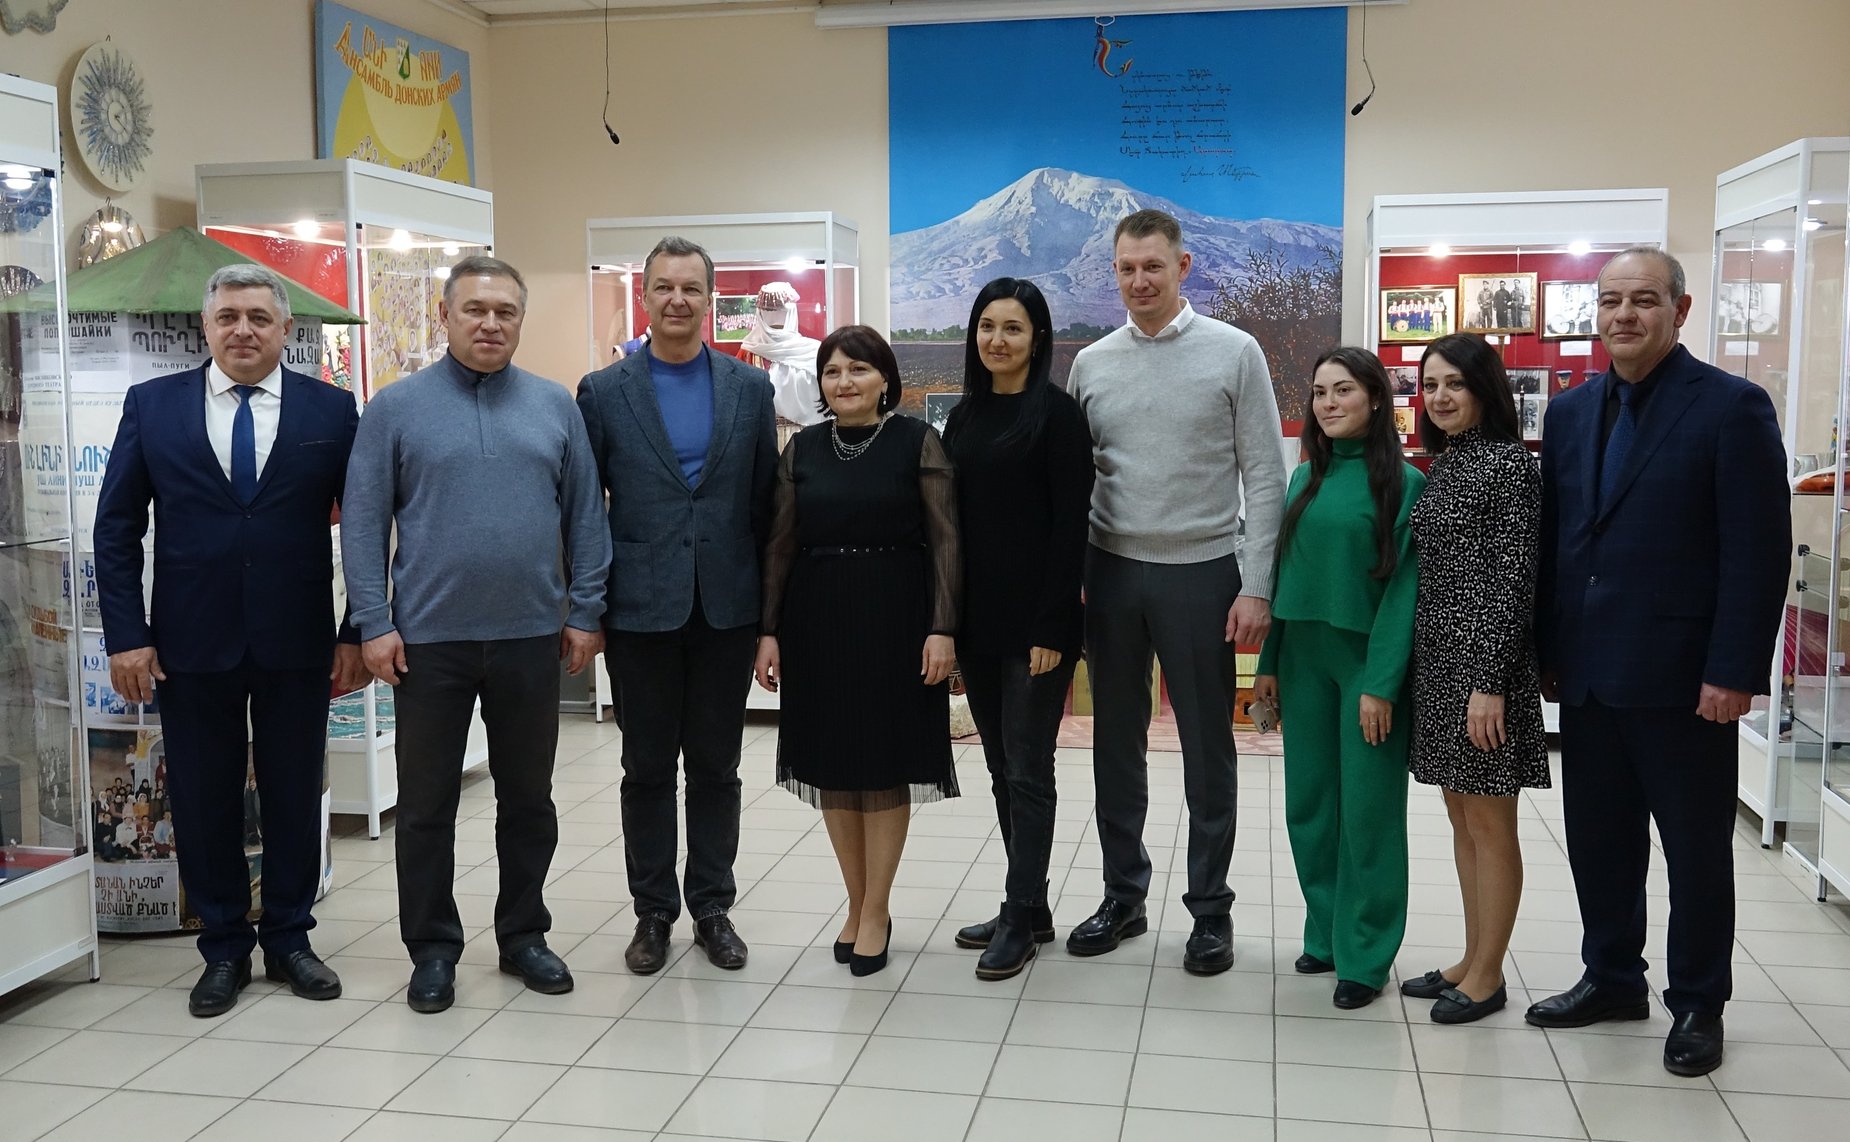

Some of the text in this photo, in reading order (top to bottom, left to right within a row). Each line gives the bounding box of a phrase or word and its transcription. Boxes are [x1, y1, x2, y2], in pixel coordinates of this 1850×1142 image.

[335, 22, 462, 107] АНСАМБЛЬ ДОНСКИХ АРМЯН
[129, 876, 164, 890] ԻՆՉԵՐ
